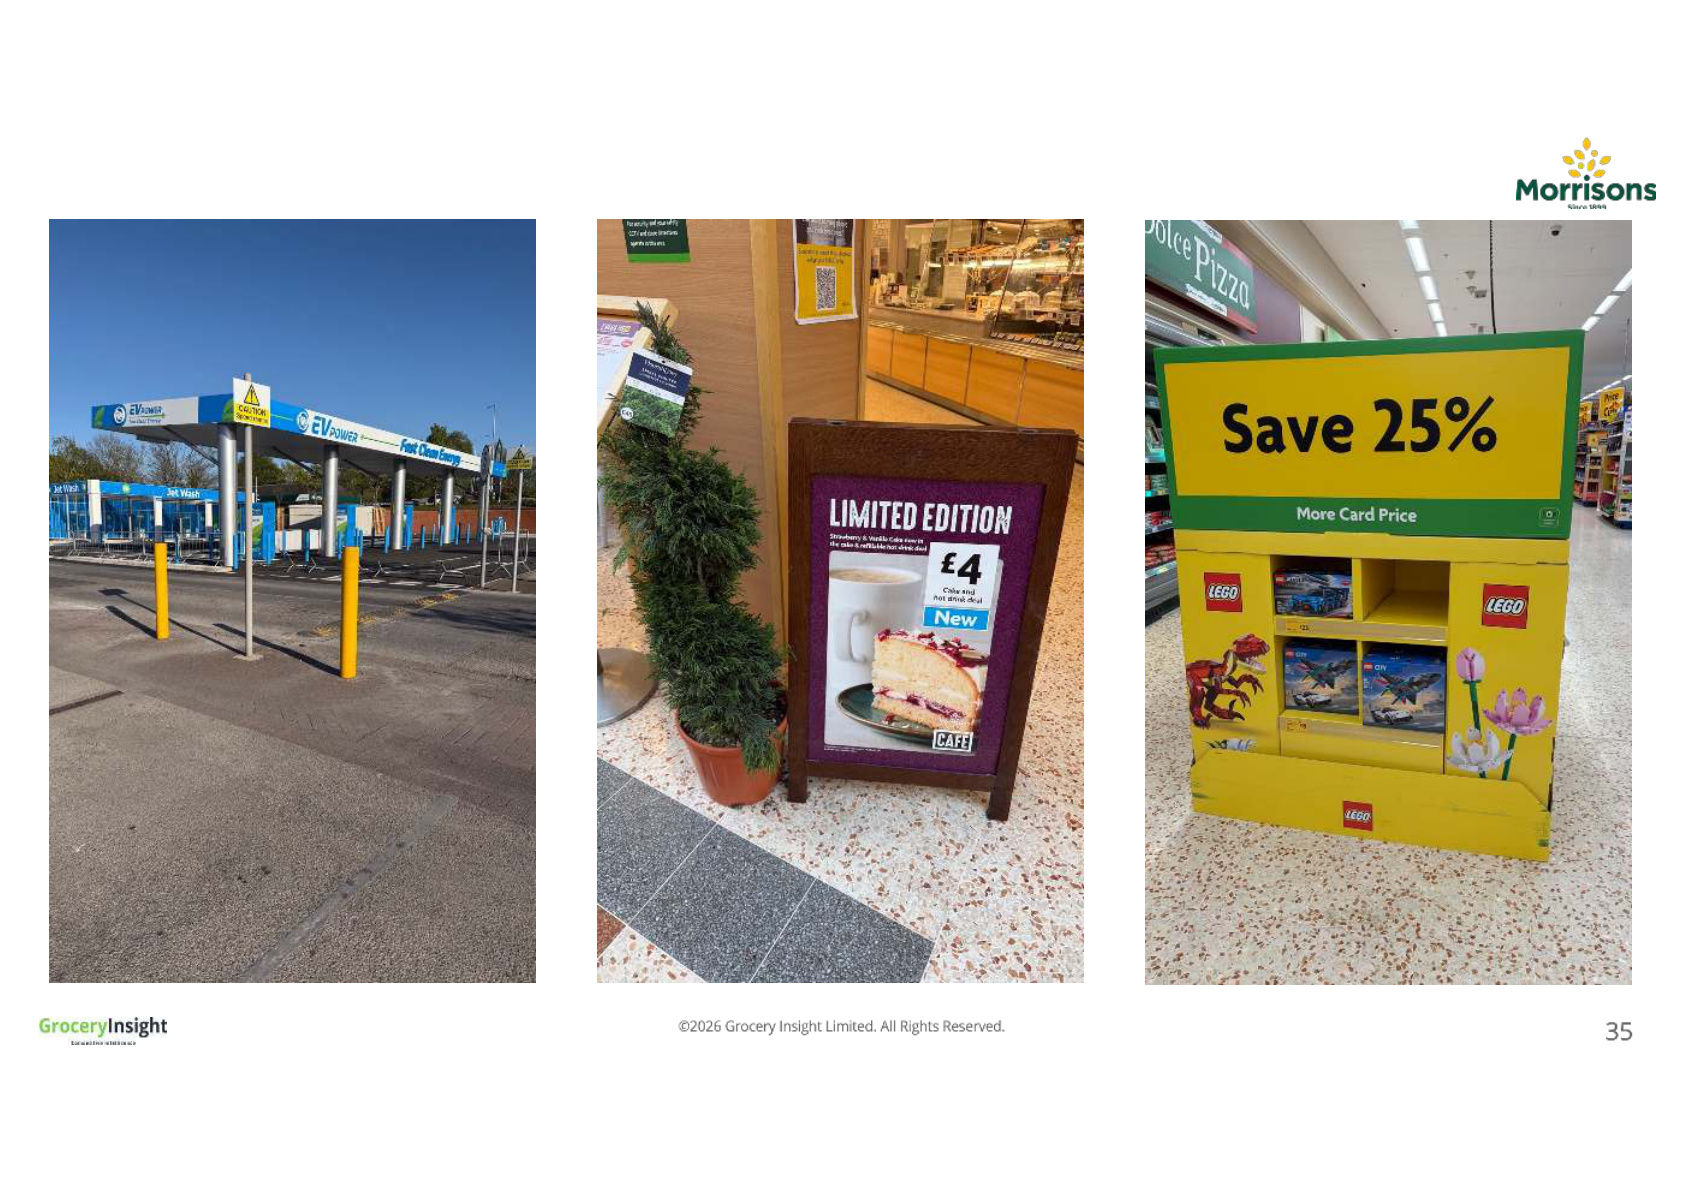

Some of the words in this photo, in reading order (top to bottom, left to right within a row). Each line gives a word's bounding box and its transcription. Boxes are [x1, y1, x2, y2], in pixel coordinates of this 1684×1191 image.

[1194, 235, 1249, 310] Pizza
[238, 404, 266, 416] CAUTION
[1223, 403, 1354, 454] Save
[1374, 396, 1497, 453] 25%
[400, 438, 418, 455] Fast
[419, 443, 438, 459] Clean
[438, 448, 461, 467] Energy
[166, 488, 179, 497] Jet
[180, 489, 200, 498] Wash
[829, 498, 918, 531] LIMITED
[922, 502, 1013, 535] EDITION
[1296, 506, 1336, 521] More
[1340, 506, 1375, 521] Card
[1379, 508, 1418, 523] Price
[829, 533, 861, 541] Strawberry
[941, 552, 982, 585] £4
[947, 595, 966, 603] drink
[966, 596, 983, 604] deal
[1209, 584, 1239, 600] LEGO
[1486, 598, 1525, 614] LEGO
[934, 610, 978, 627] New
[936, 732, 969, 749] CAFE
[1345, 809, 1371, 822] LEGO
